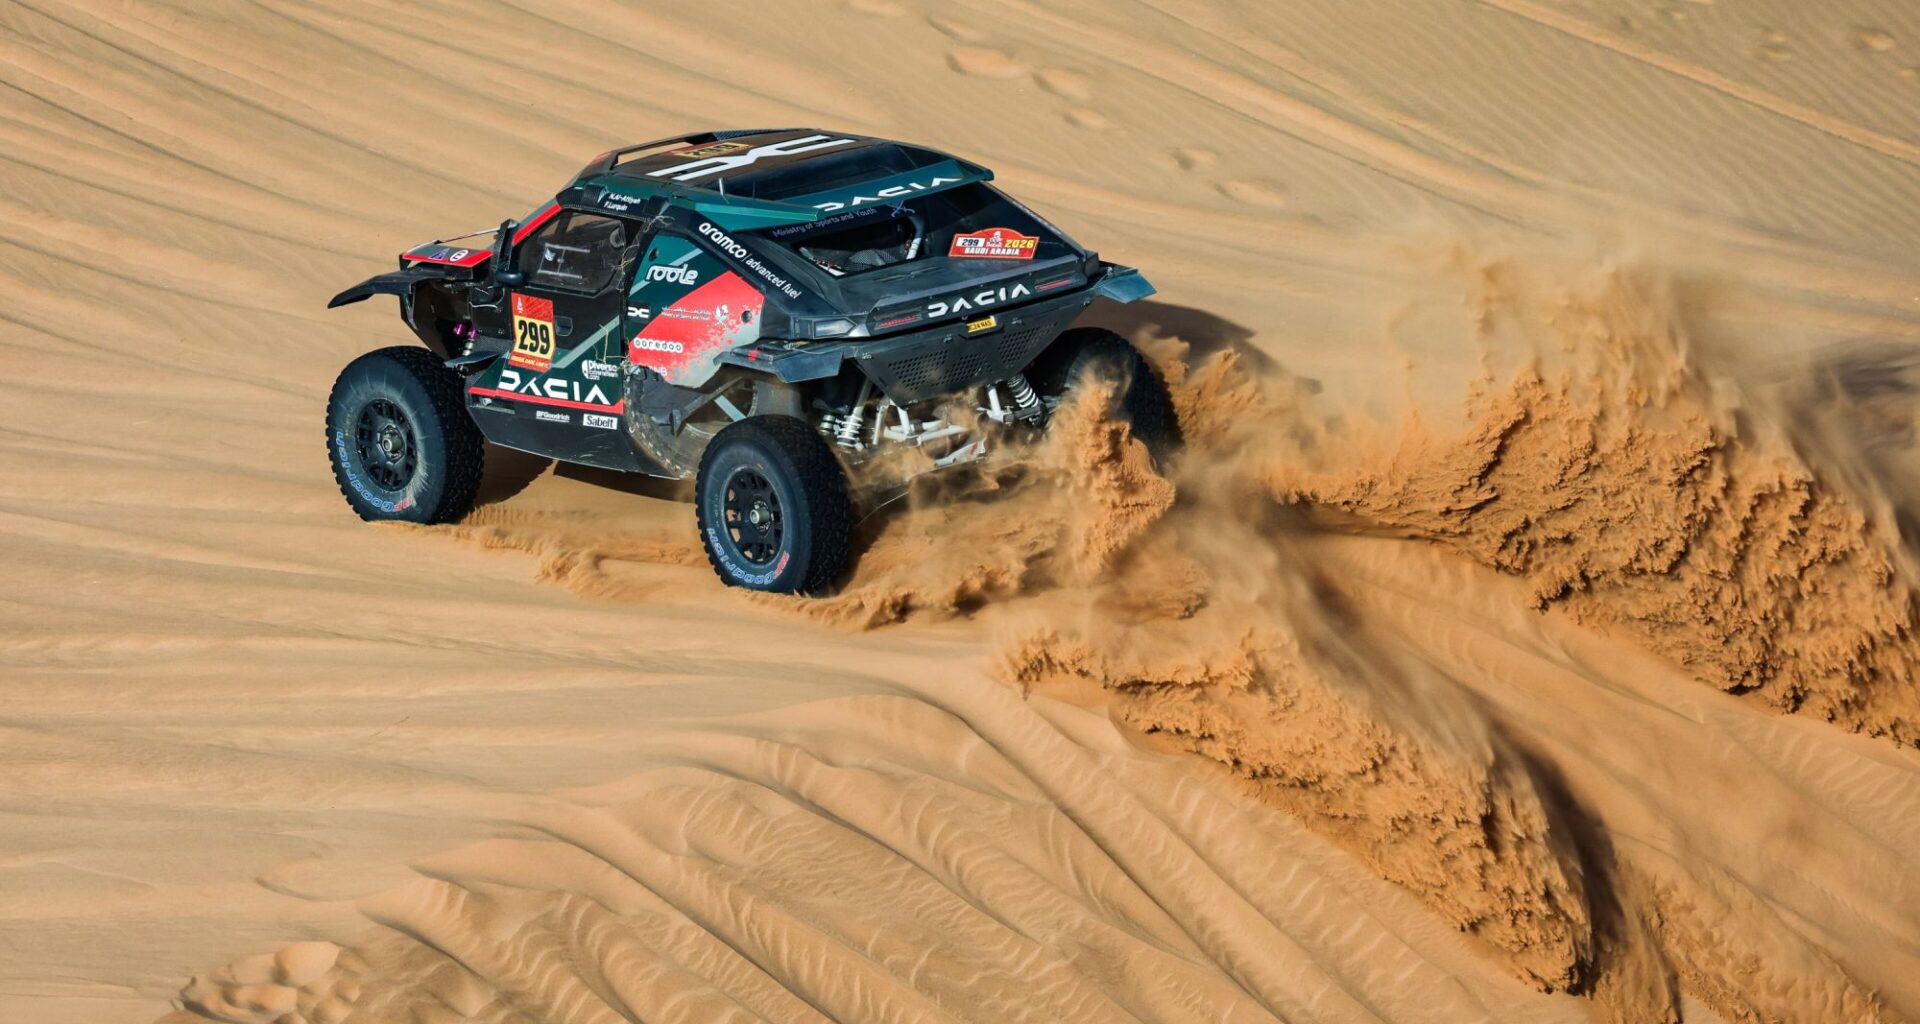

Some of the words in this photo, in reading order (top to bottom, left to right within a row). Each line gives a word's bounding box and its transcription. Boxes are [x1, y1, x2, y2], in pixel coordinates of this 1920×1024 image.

[813, 177, 963, 211] DACIA
[772, 225, 805, 238] Ministry
[805, 222, 814, 231] of
[814, 216, 840, 228] Sports
[840, 213, 854, 222] and
[855, 207, 877, 218] Youth
[961, 238, 979, 247] 299
[1004, 239, 1034, 248] 2026
[964, 247, 988, 255] SAUDI
[990, 247, 1019, 256] ARABIA
[698, 222, 747, 259] aramco
[745, 258, 786, 287] advanced
[781, 283, 802, 299] fuel
[646, 264, 698, 285] roole
[928, 284, 1031, 318] DACIA
[518, 319, 551, 355] 299
[635, 340, 682, 352] ooredoo
[588, 360, 618, 372] Diverse
[498, 369, 611, 405] DACIA
[536, 410, 570, 421] BFGoodrich
[586, 415, 614, 428] Sabelt
